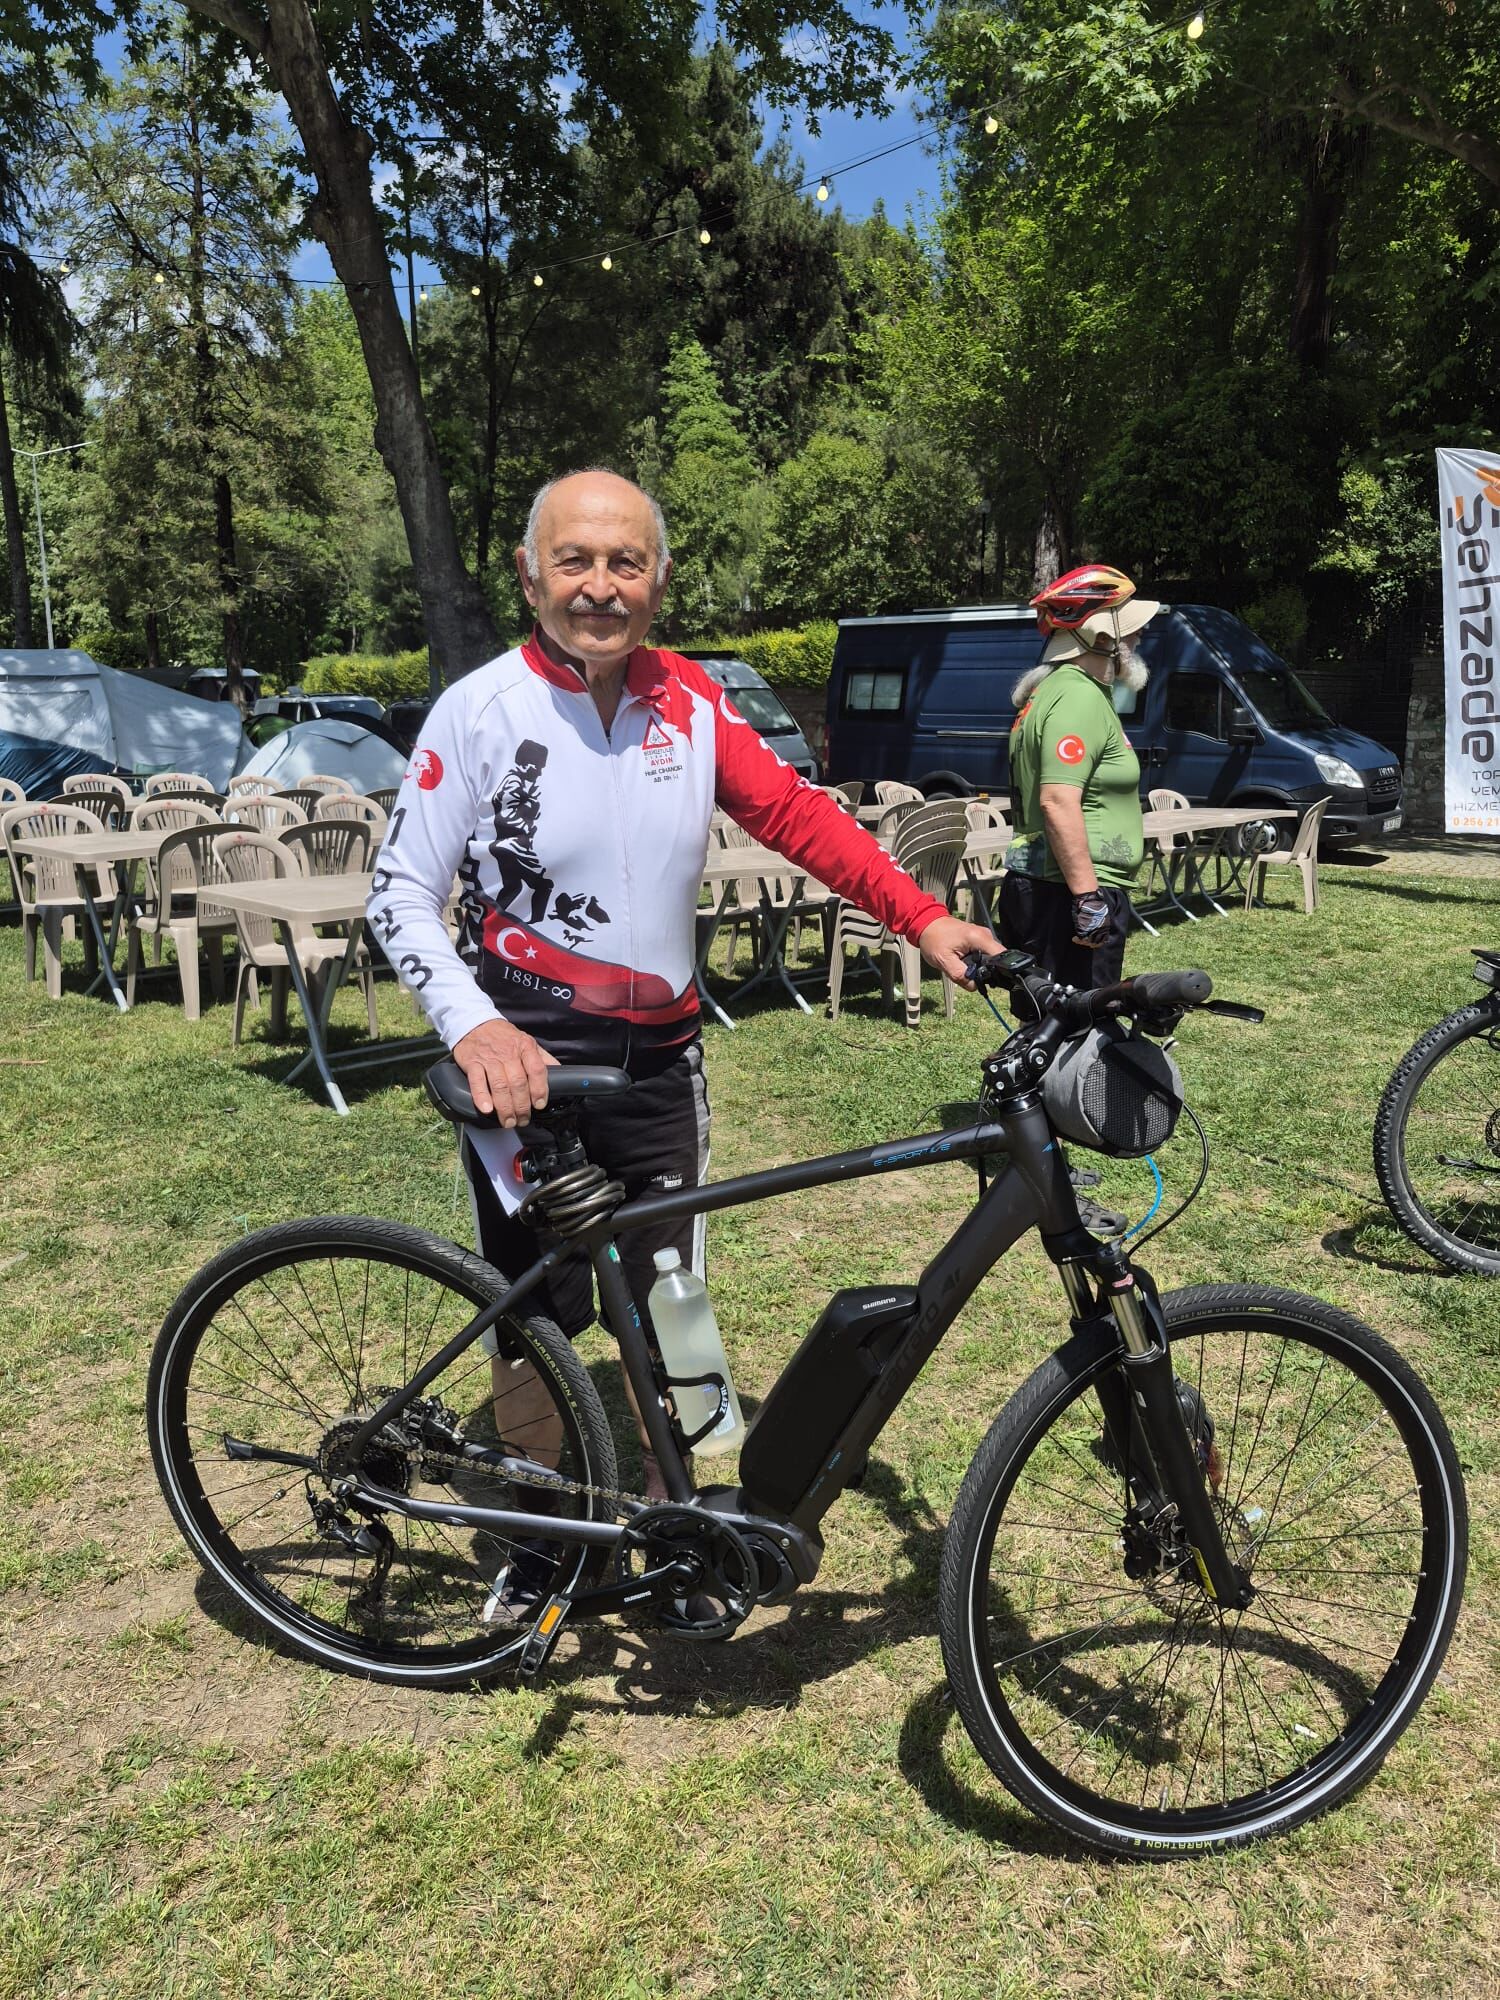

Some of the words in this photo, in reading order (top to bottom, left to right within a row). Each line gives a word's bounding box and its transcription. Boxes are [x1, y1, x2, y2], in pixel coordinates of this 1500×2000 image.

[651, 757, 673, 766] AYDIN
[532, 1337, 573, 1397] MARATHON
[1100, 1826, 1129, 1843] PLUS
[1146, 1839, 1213, 1850] MARATHON
